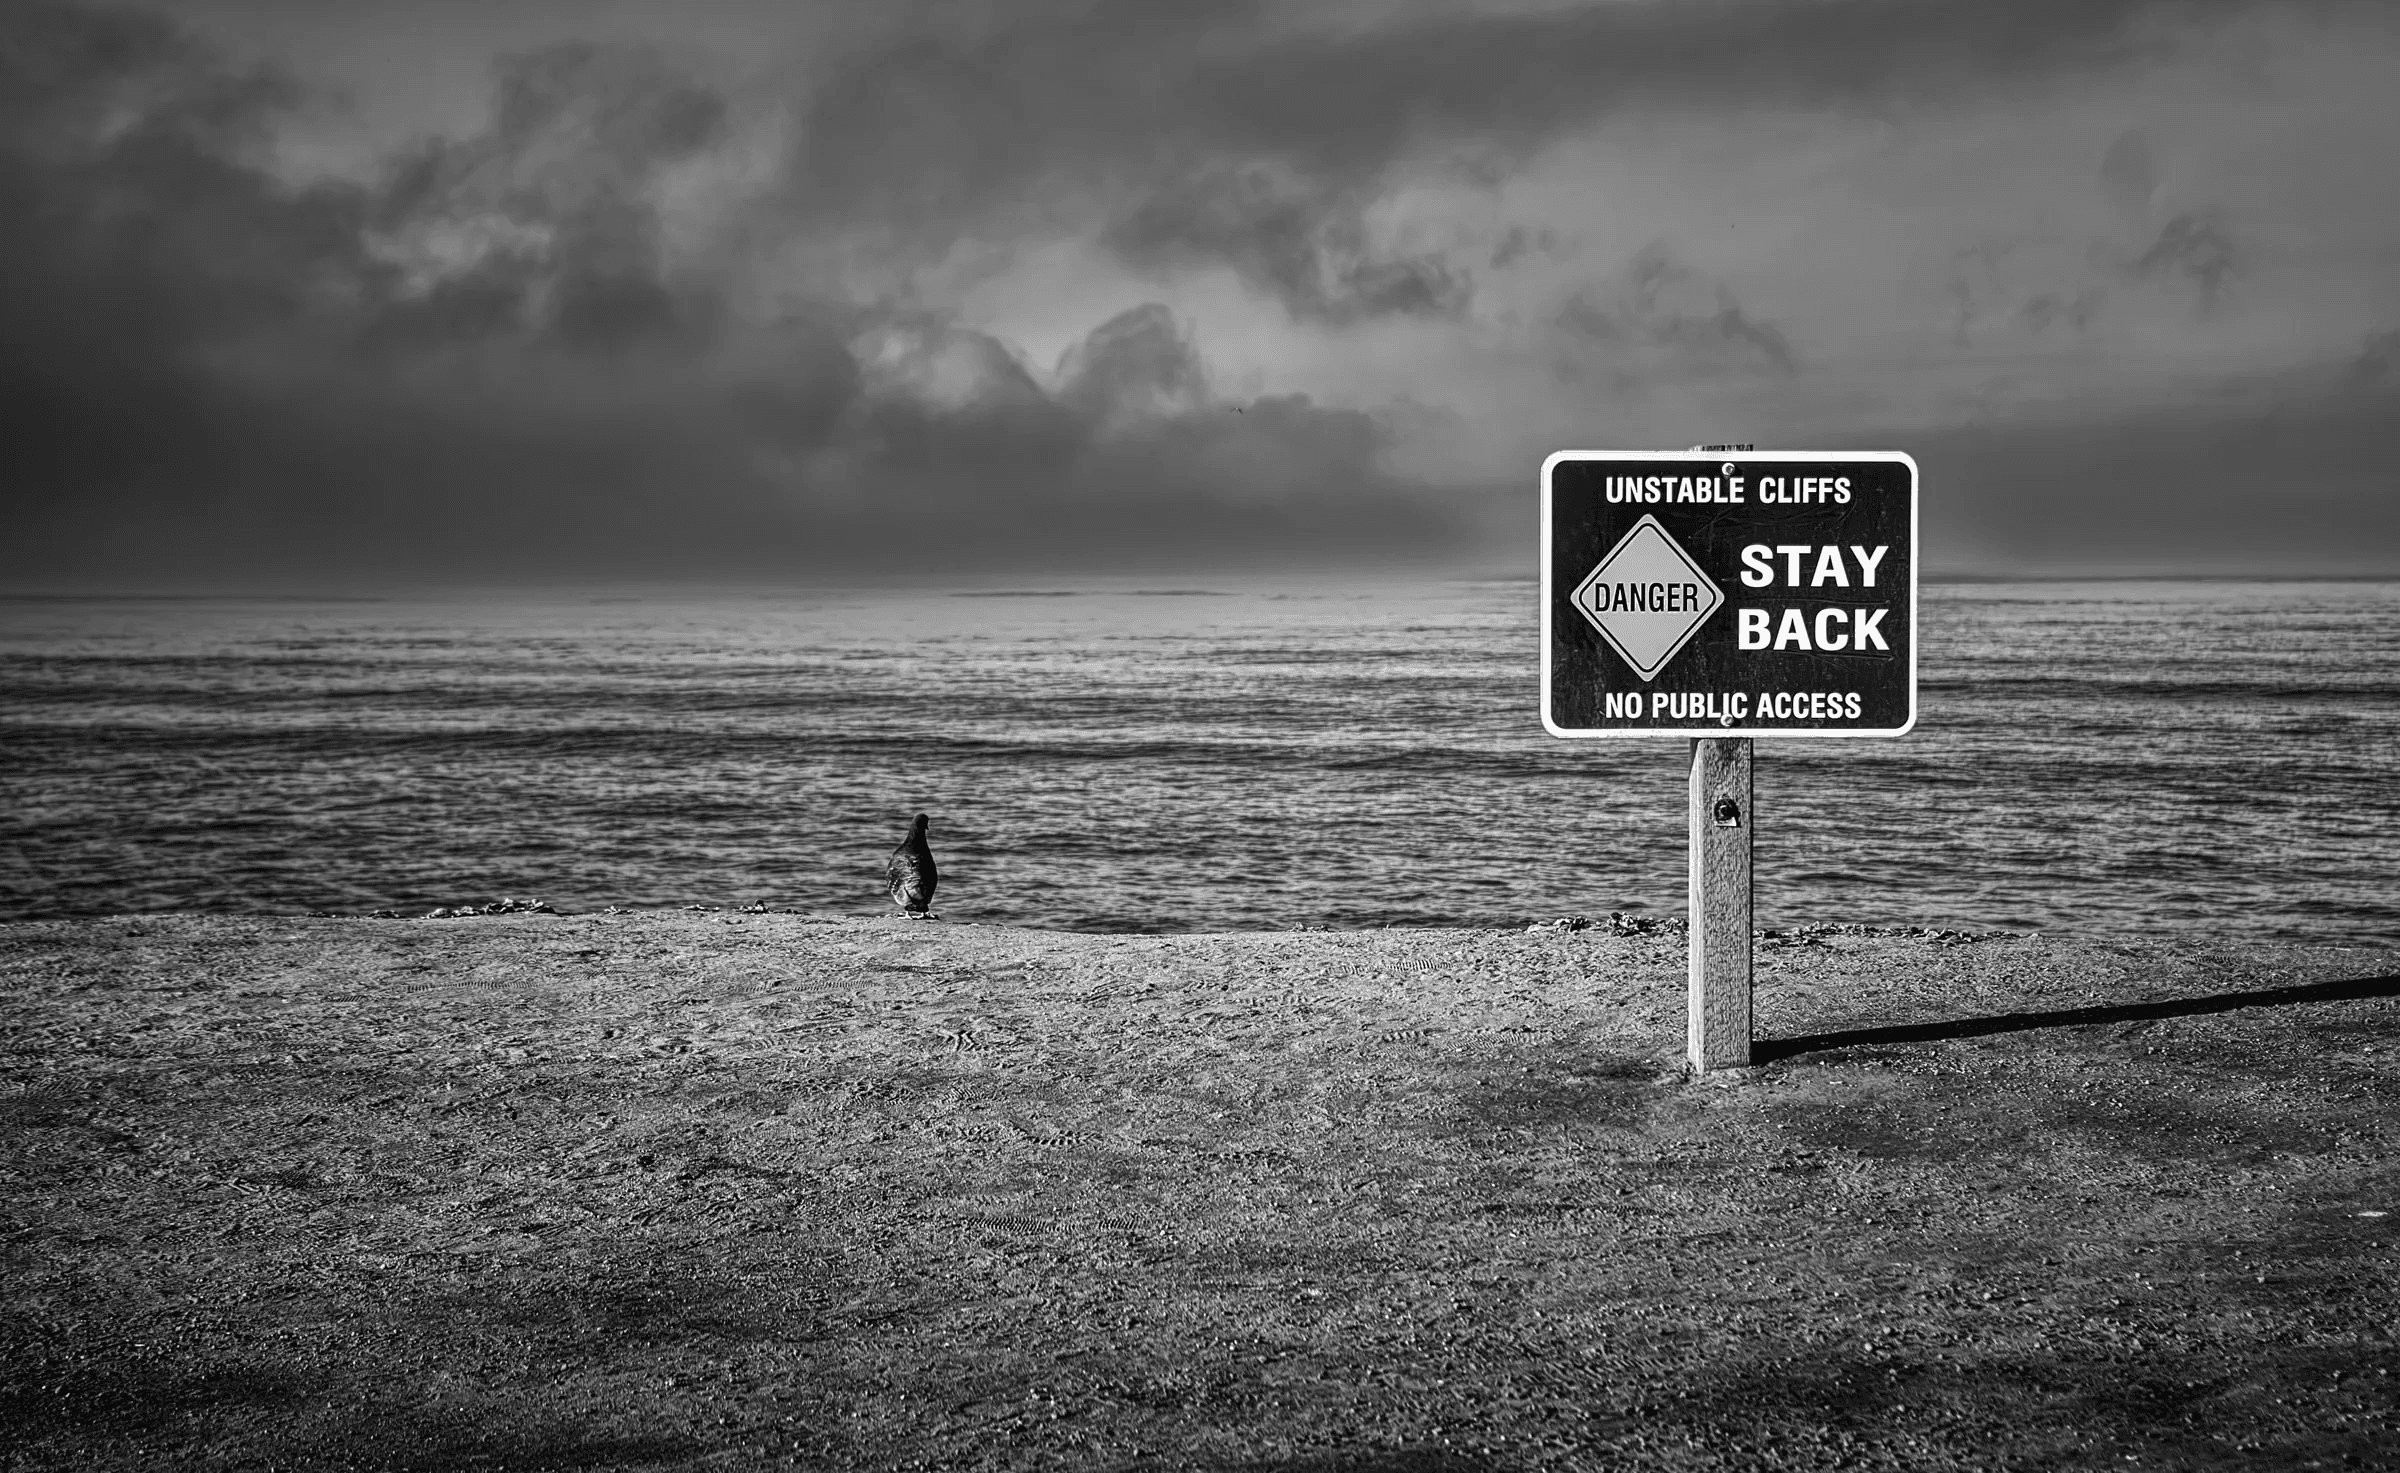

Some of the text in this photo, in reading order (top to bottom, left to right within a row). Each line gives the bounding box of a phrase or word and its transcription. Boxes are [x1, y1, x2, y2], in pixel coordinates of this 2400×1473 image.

[1606, 476, 1851, 504] UNSTABLE CLIFFS
[1740, 544, 1889, 588] STAY
[1595, 583, 1699, 612] DANGER
[1738, 608, 1890, 651] BACK
[1605, 692, 1862, 719] NO PUBLIC ACCESS
